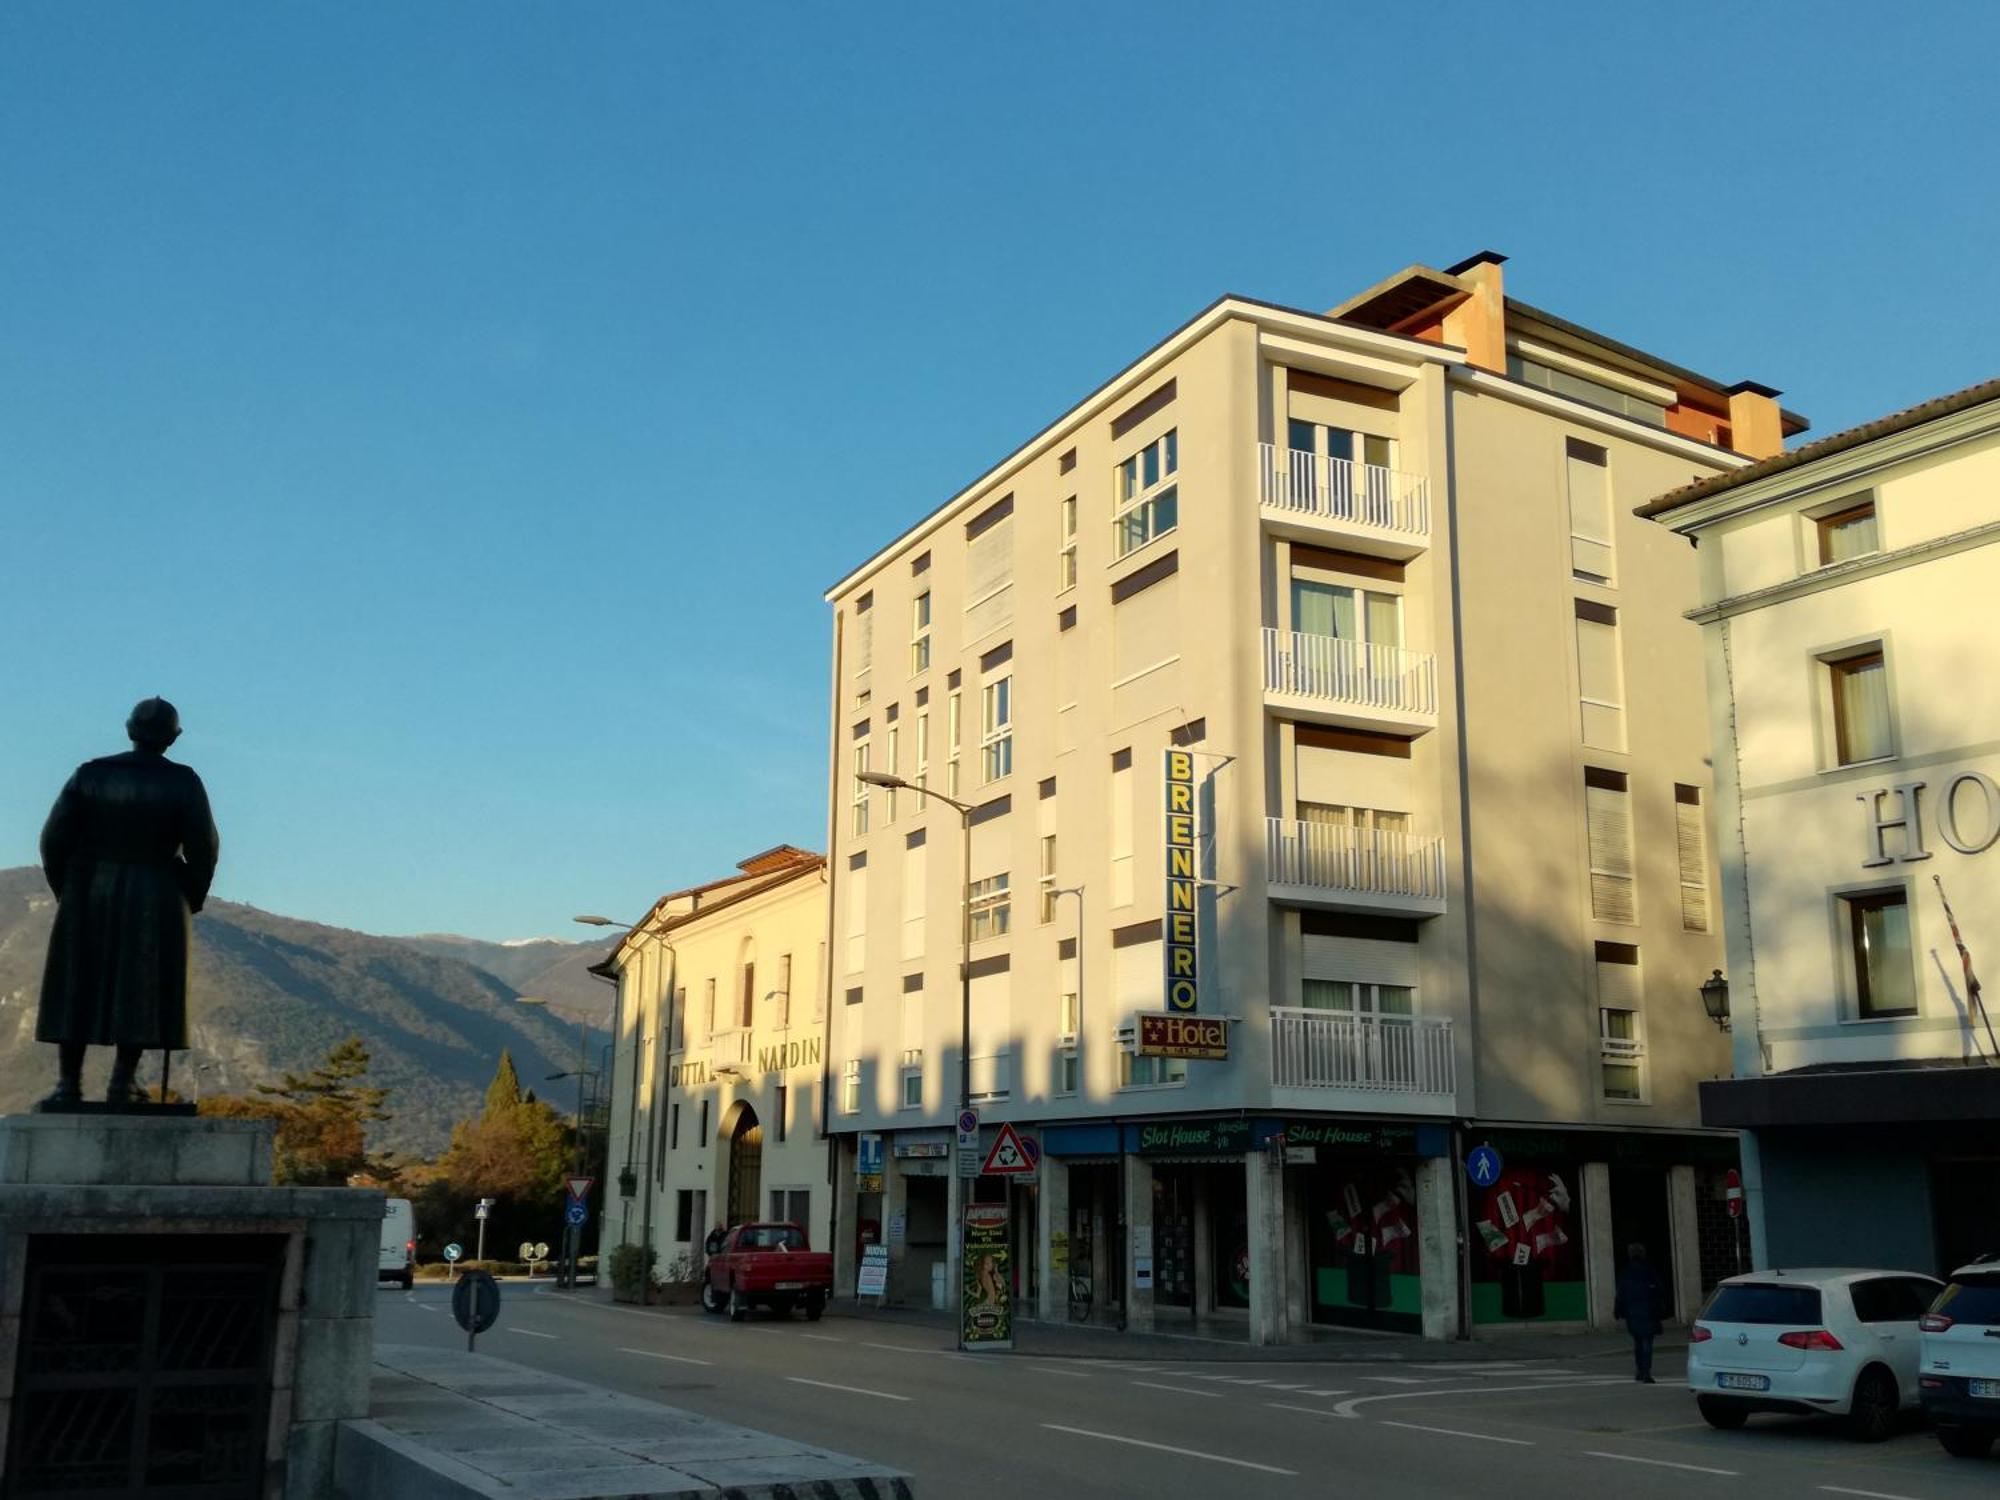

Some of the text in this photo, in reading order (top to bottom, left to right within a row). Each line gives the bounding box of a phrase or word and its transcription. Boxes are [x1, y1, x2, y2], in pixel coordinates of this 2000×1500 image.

[1856, 770, 2000, 868] HO
[1170, 751, 1196, 1010] BRENNERO
[1167, 1019, 1226, 1046] Hotel
[671, 1061, 705, 1088] DITTA
[1142, 1125, 1211, 1148] Slot House
[1287, 1125, 1372, 1145] Slot House
